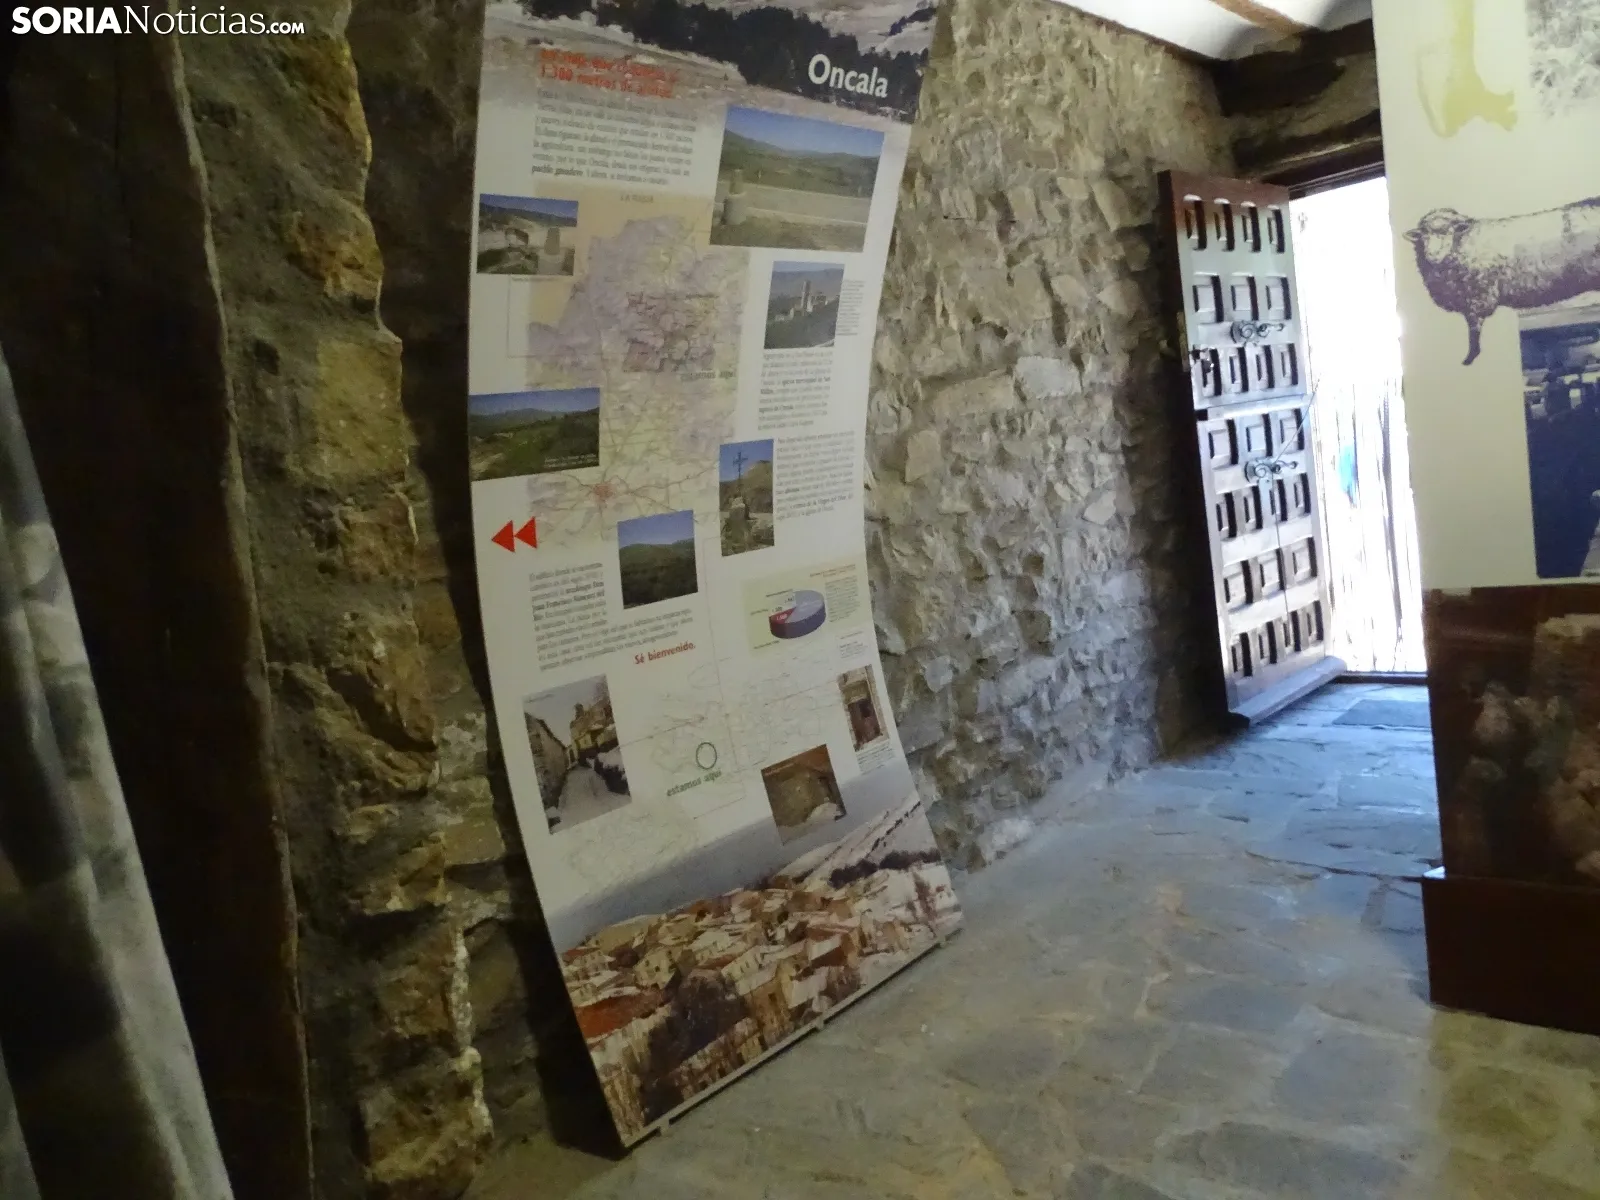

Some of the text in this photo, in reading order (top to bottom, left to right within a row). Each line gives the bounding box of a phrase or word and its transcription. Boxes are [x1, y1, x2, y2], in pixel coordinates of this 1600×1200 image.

[808, 53, 888, 98] Oncala
[634, 641, 697, 665] Sé bienvenido.
[666, 777, 702, 797] estamos
